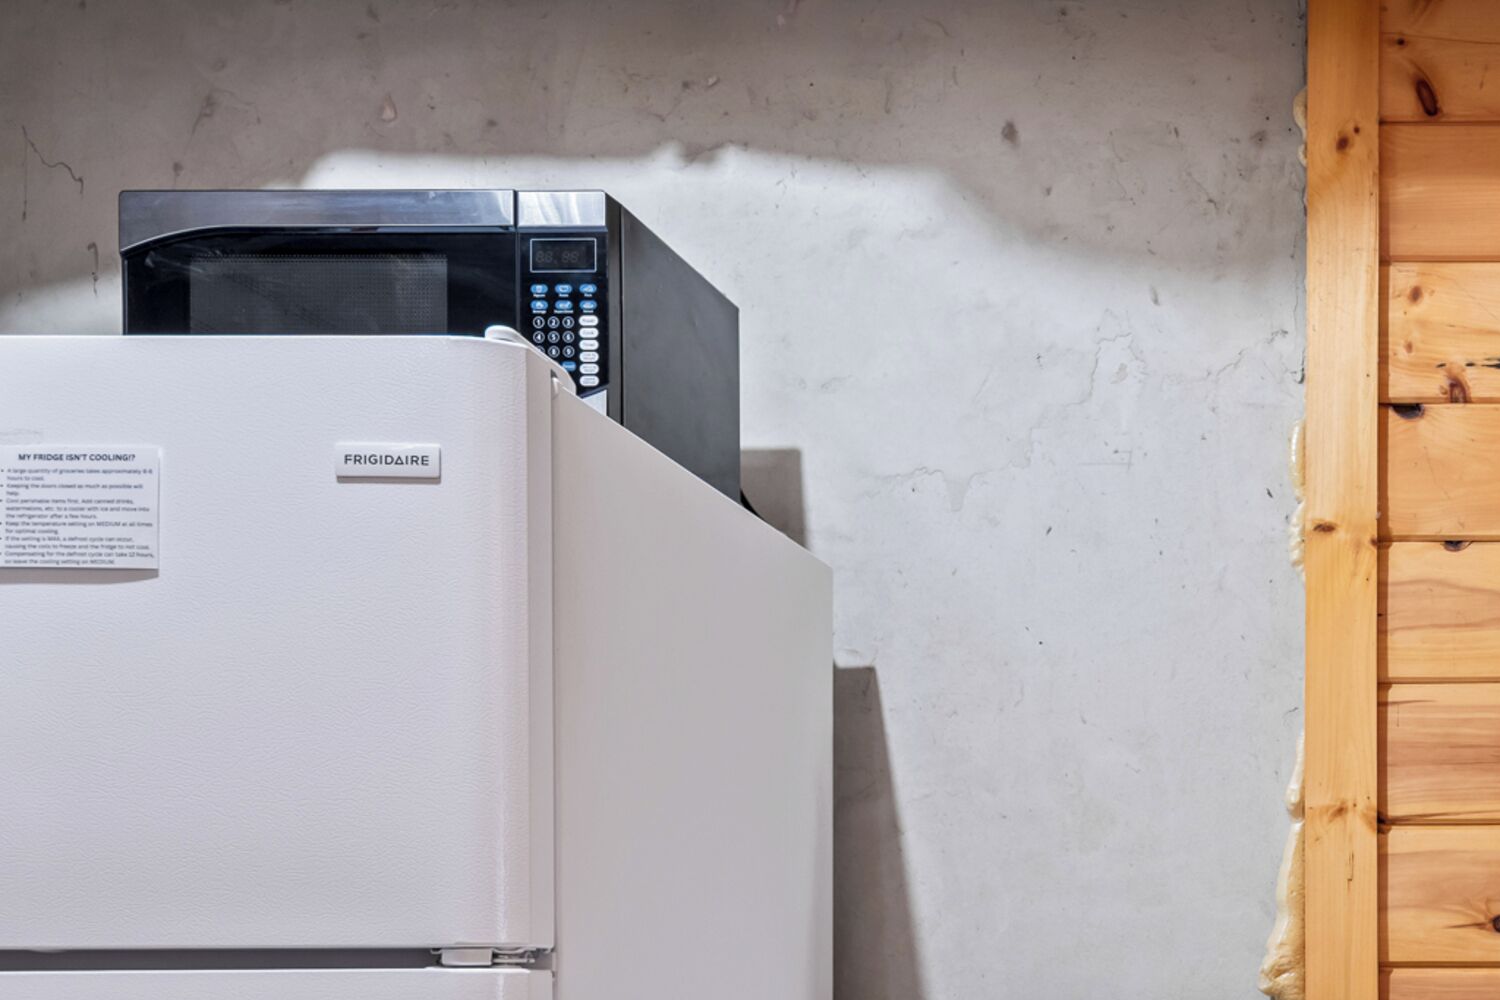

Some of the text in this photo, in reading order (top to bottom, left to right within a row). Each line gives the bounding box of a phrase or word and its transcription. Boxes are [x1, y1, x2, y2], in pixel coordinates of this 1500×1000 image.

[18, 453, 32, 461] MY
[33, 453, 64, 461] FRIDGE
[65, 453, 87, 461] ISN'T
[343, 453, 430, 466] FRIGIDAIRE
